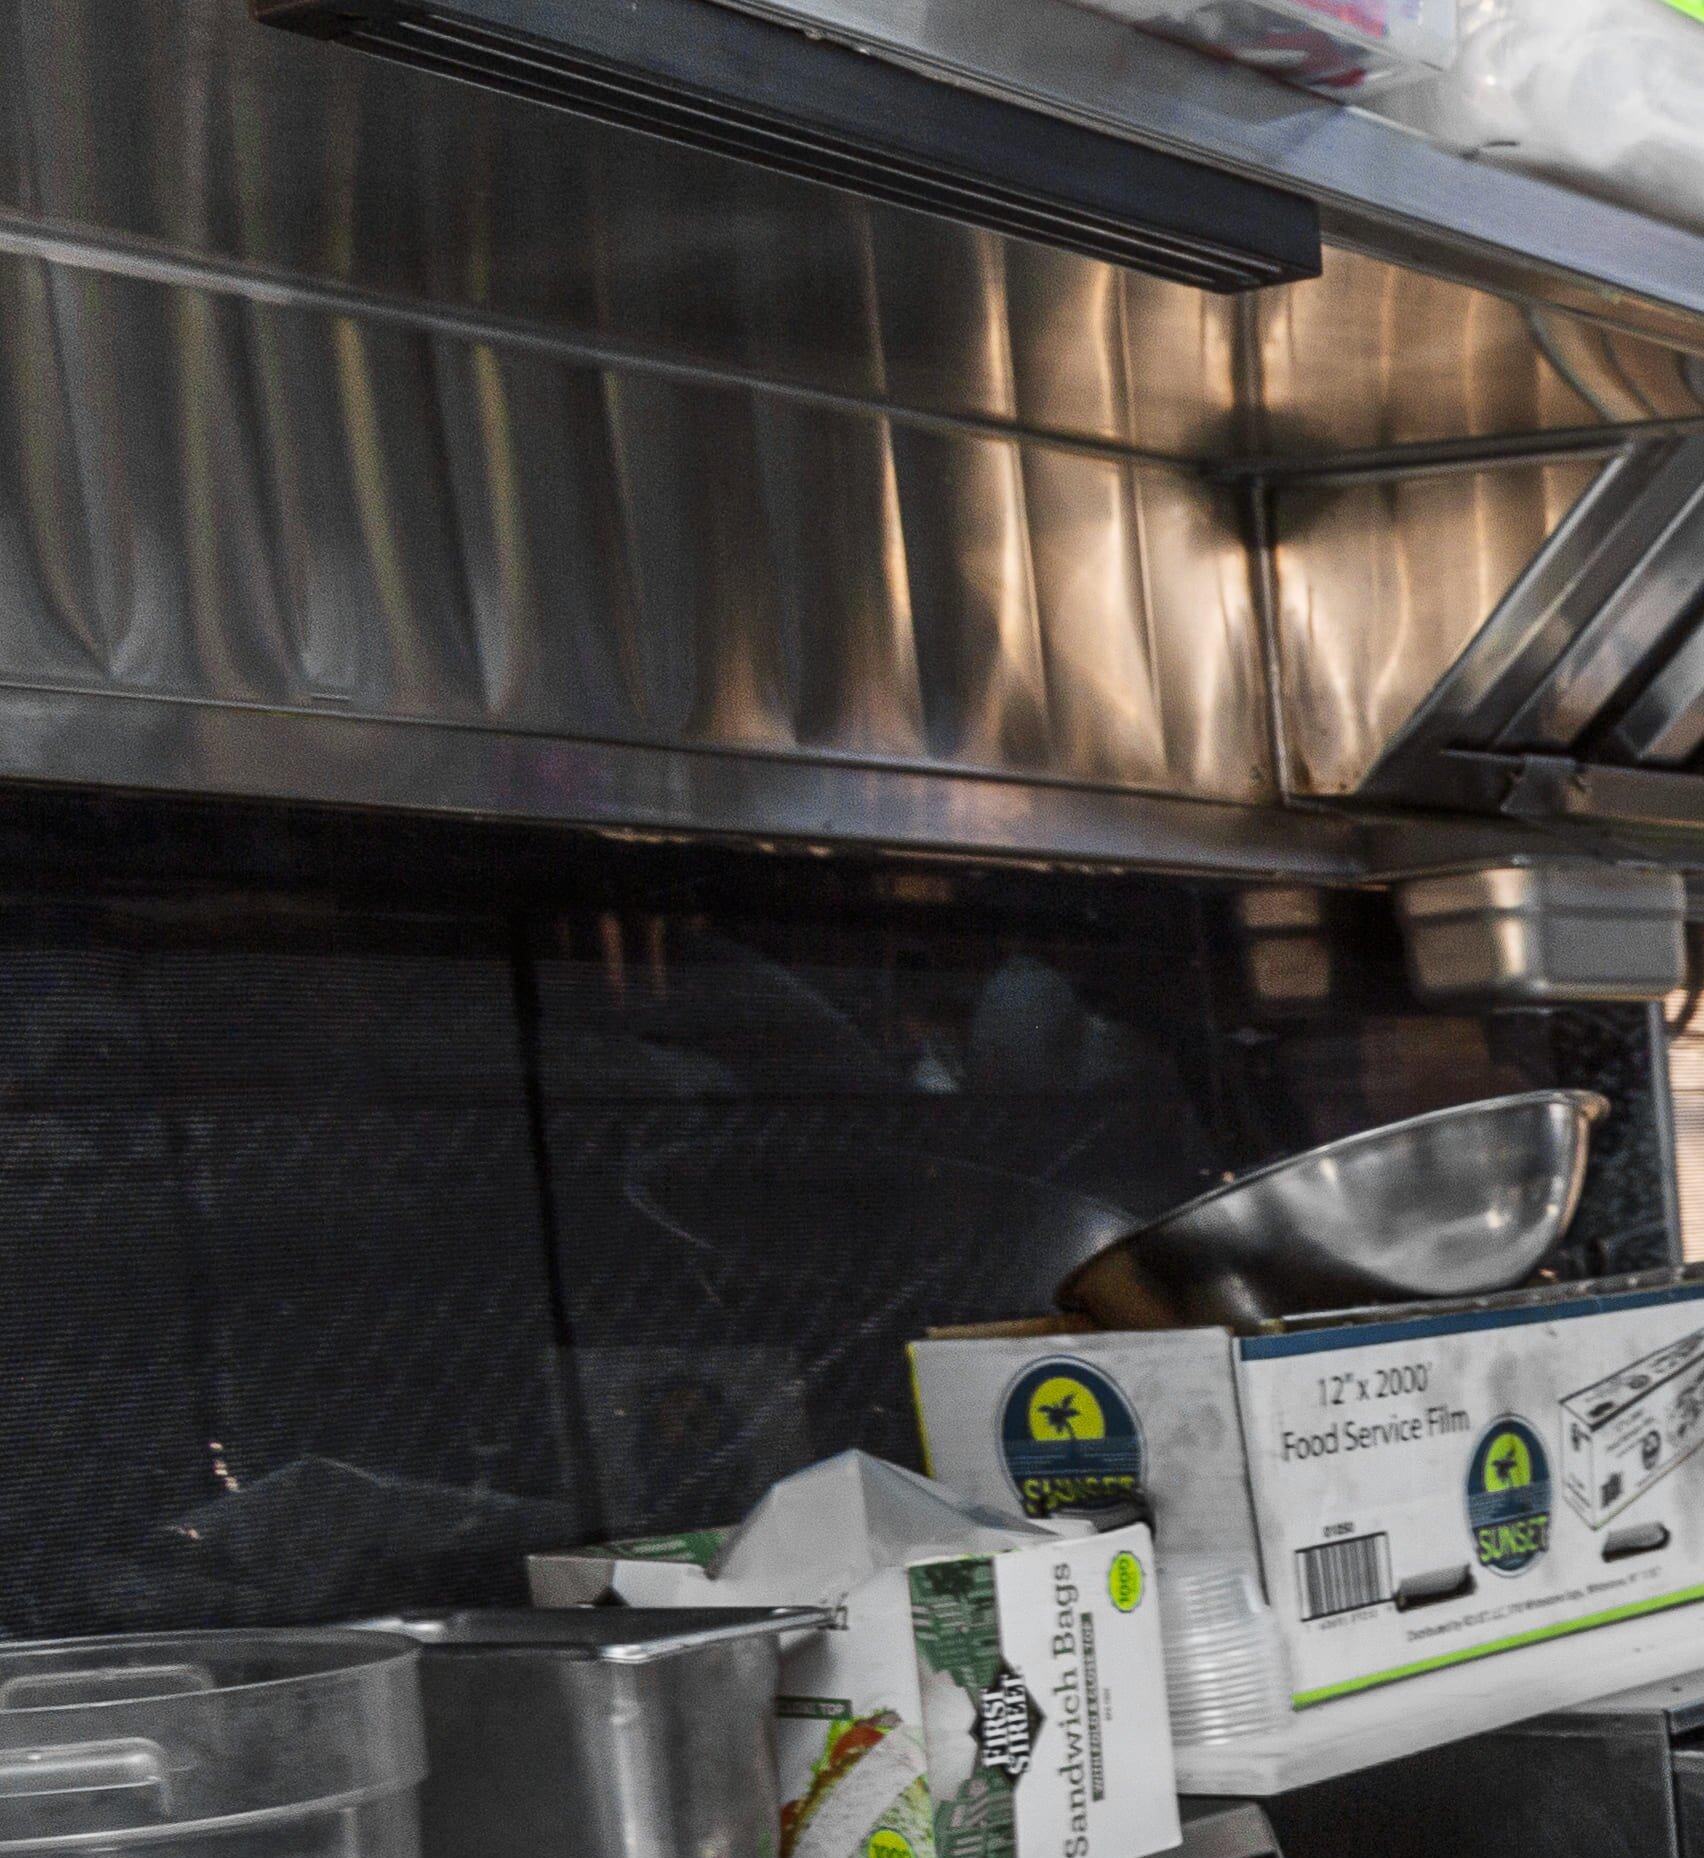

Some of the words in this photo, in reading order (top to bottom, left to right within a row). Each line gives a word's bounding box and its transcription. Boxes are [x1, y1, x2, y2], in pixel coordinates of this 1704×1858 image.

[1357, 1377, 1370, 1401] x
[1280, 1422, 1339, 1462] Food
[1343, 1412, 1422, 1451] Service
[1426, 1402, 1471, 1438] Film
[1477, 1514, 1550, 1564] SUNSET
[1052, 1561, 1080, 1659] Bags
[980, 1687, 1010, 1768] FIRST
[1001, 1673, 1031, 1776] STREET
